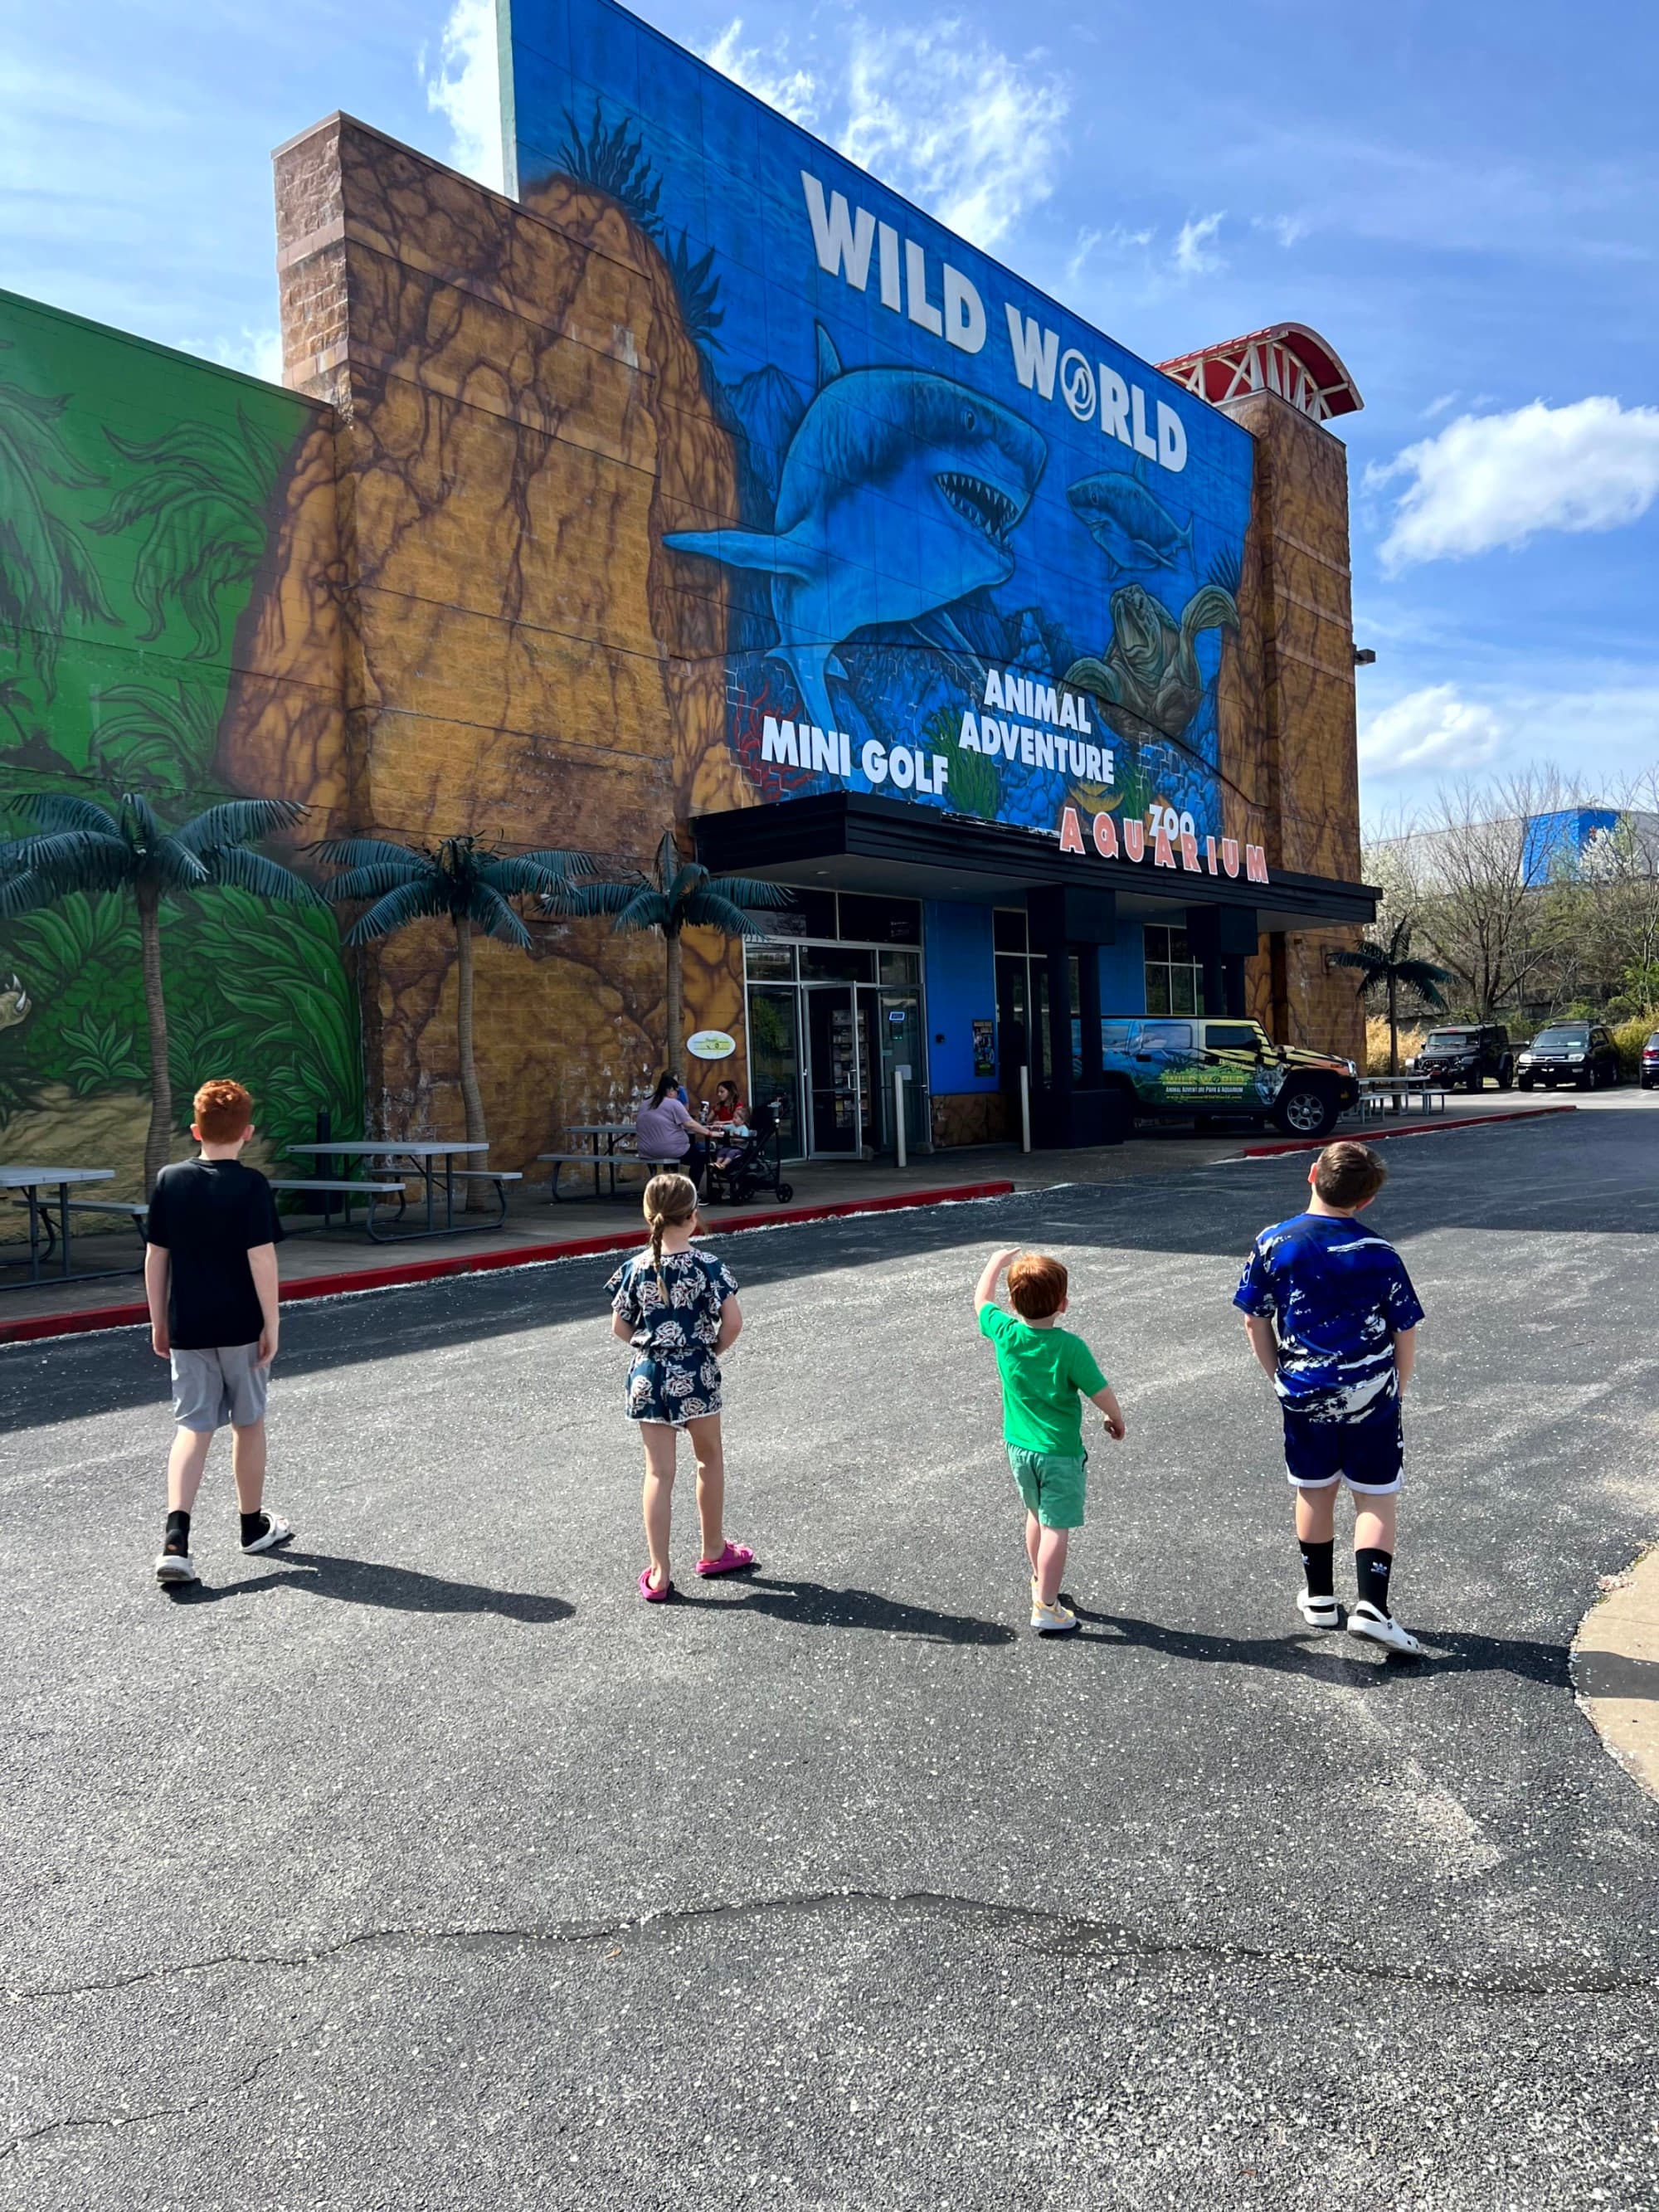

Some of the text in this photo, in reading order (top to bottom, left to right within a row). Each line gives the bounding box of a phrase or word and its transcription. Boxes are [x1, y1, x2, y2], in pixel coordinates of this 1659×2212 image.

[800, 170, 1187, 472] WILD WORLD
[983, 670, 1092, 734] ANIMAL
[761, 715, 948, 795] MINI GOLF
[958, 711, 1114, 785] ADVENTURE
[1059, 806, 1269, 884] AQUARIUM
[1149, 804, 1194, 841] ZOO
[1165, 1074, 1244, 1084] WILD WORLD
